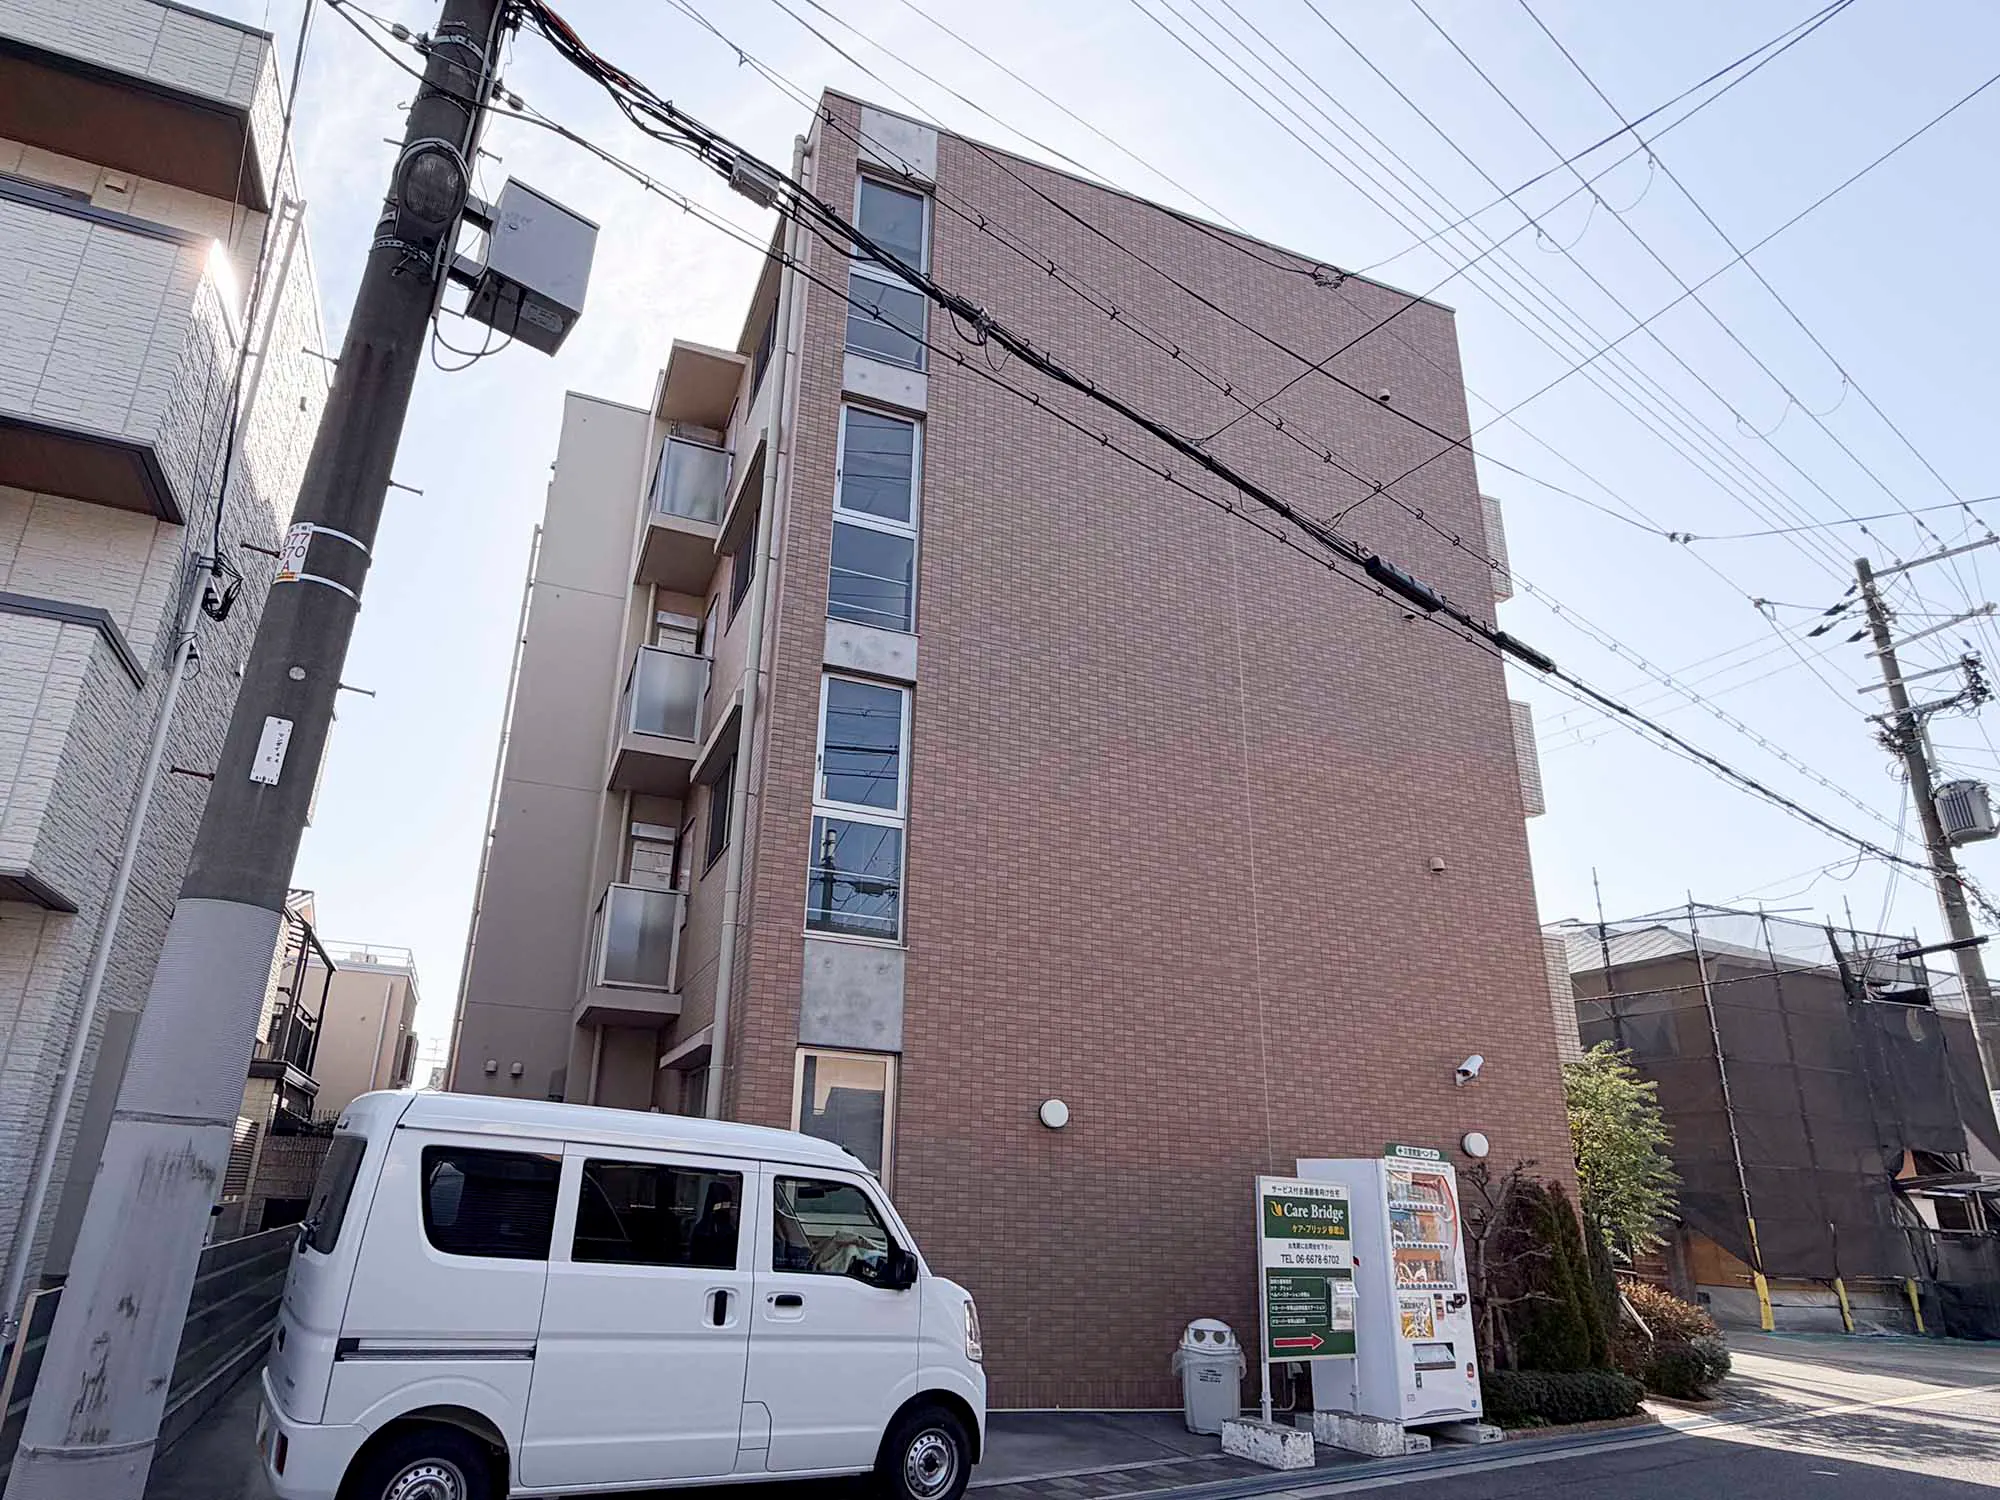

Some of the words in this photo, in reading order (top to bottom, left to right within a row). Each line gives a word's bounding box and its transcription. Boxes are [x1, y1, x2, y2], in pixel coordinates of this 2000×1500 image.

[1283, 1202, 1309, 1218] Care
[1311, 1203, 1344, 1223] Bridge
[1280, 1253, 1294, 1264] TEL
